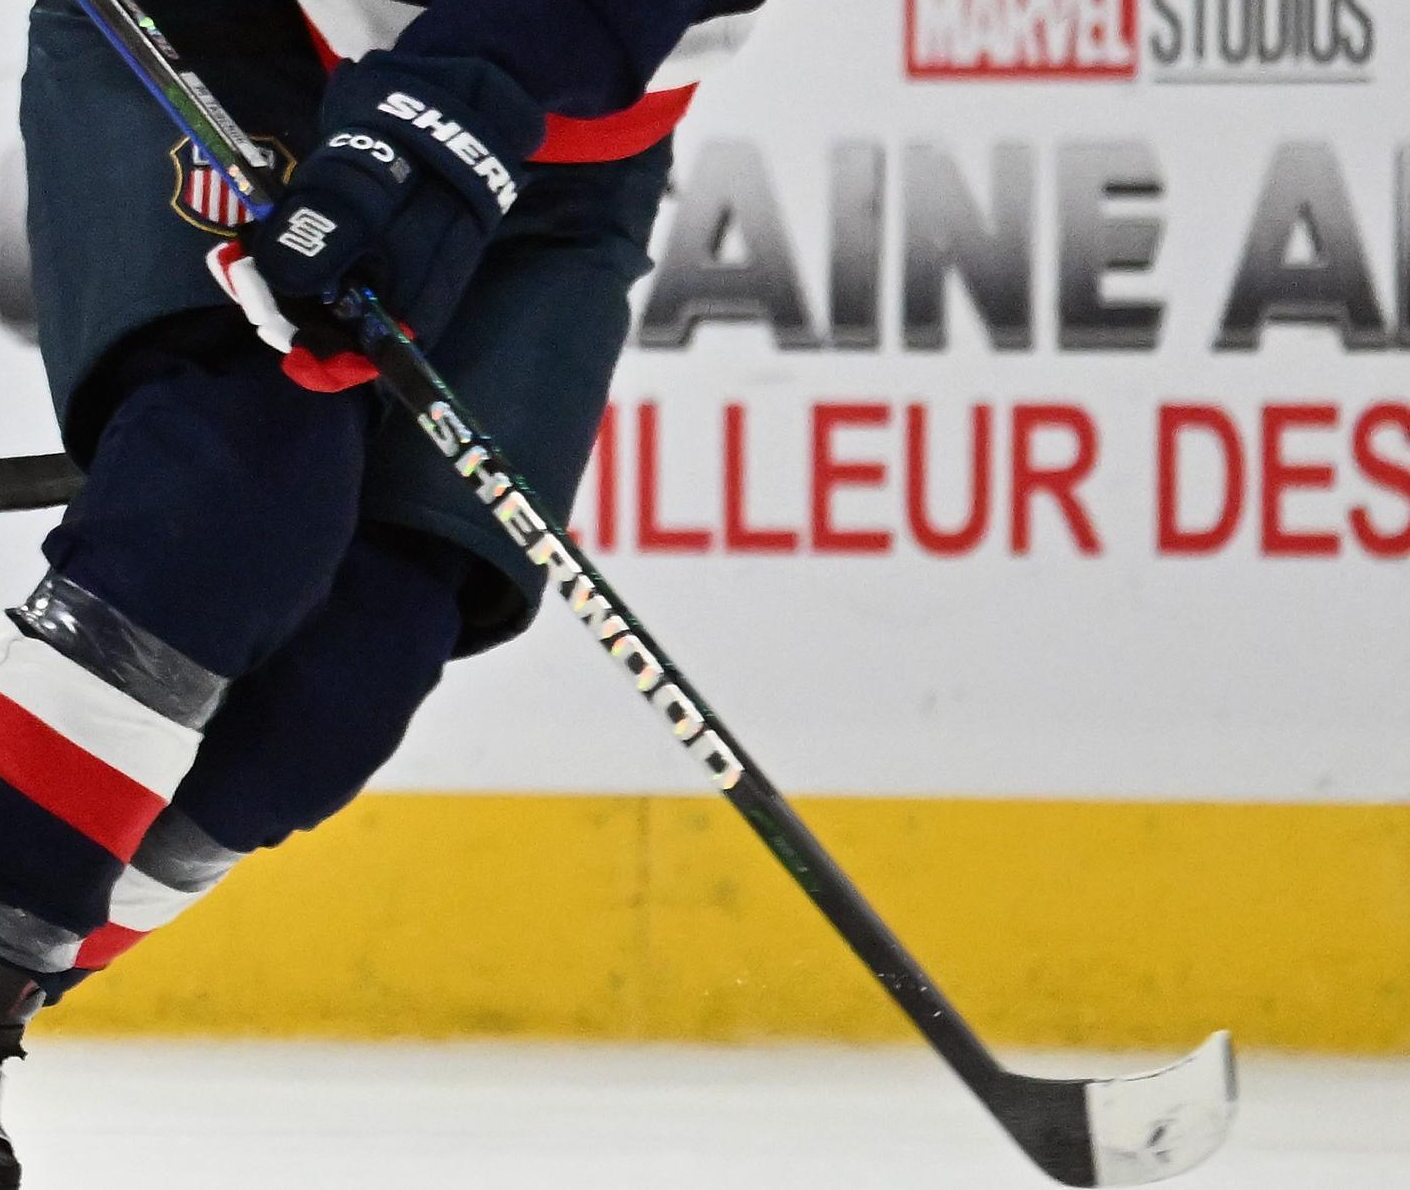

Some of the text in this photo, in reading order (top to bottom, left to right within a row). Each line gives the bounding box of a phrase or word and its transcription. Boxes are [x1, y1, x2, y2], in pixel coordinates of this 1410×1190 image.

[1211, 140, 1410, 352] A
[571, 401, 1410, 558] ILLEUR DES
[417, 400, 745, 791] SHERWOOD
